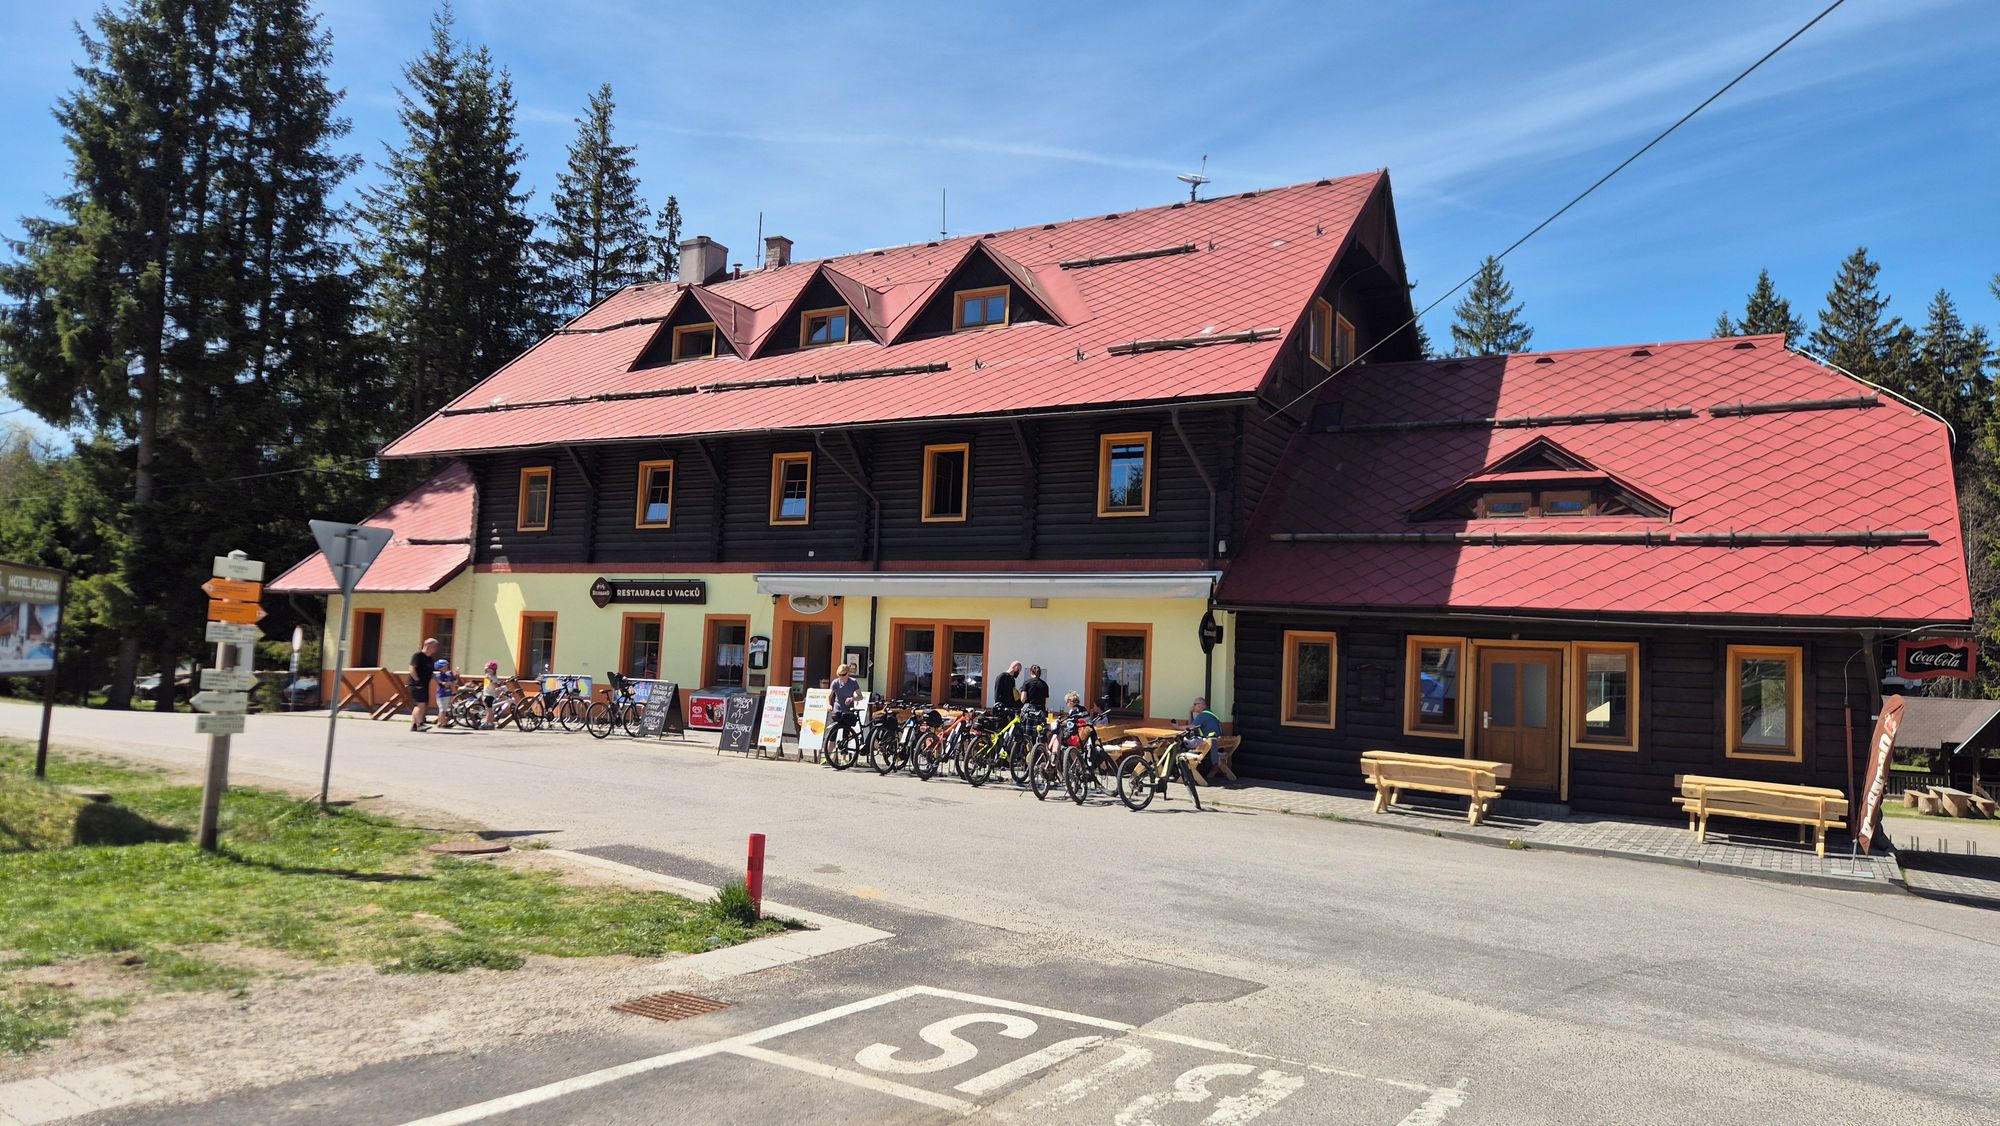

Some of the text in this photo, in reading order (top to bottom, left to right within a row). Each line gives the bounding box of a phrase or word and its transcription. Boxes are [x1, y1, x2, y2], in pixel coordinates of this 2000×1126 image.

[8, 575, 30, 590] HOTEL
[616, 587, 700, 597] RESTAURACE U VACKŮ
